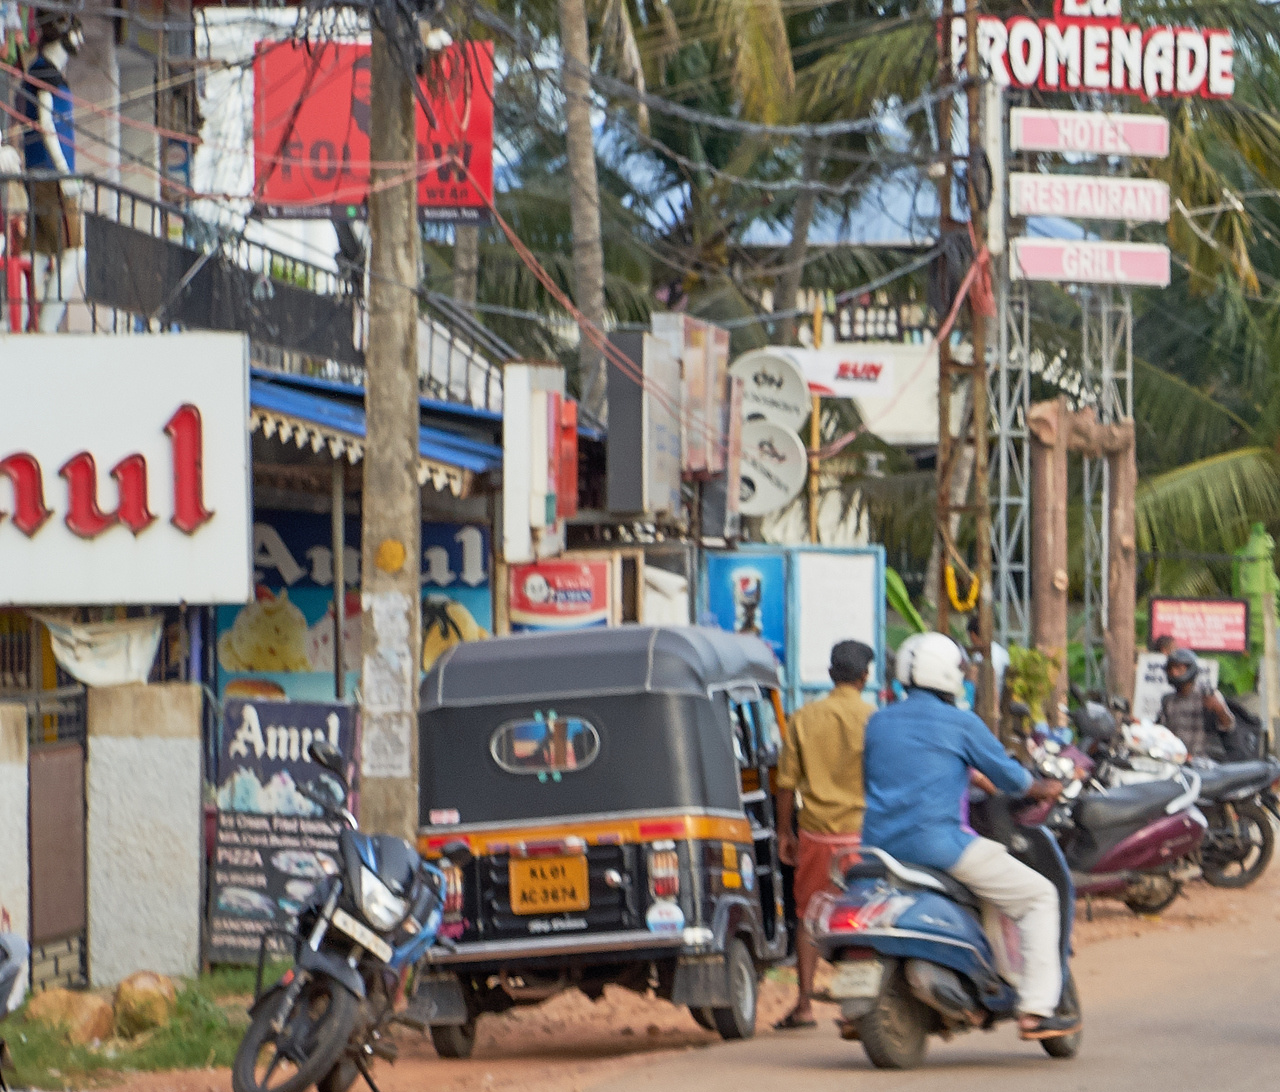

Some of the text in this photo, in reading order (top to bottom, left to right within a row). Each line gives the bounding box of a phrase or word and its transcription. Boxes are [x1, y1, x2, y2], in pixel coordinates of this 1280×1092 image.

[1057, 118, 1132, 151] HOTEL
[1020, 181, 1167, 217] RESTAURANT
[1061, 247, 1128, 280] GRILL
